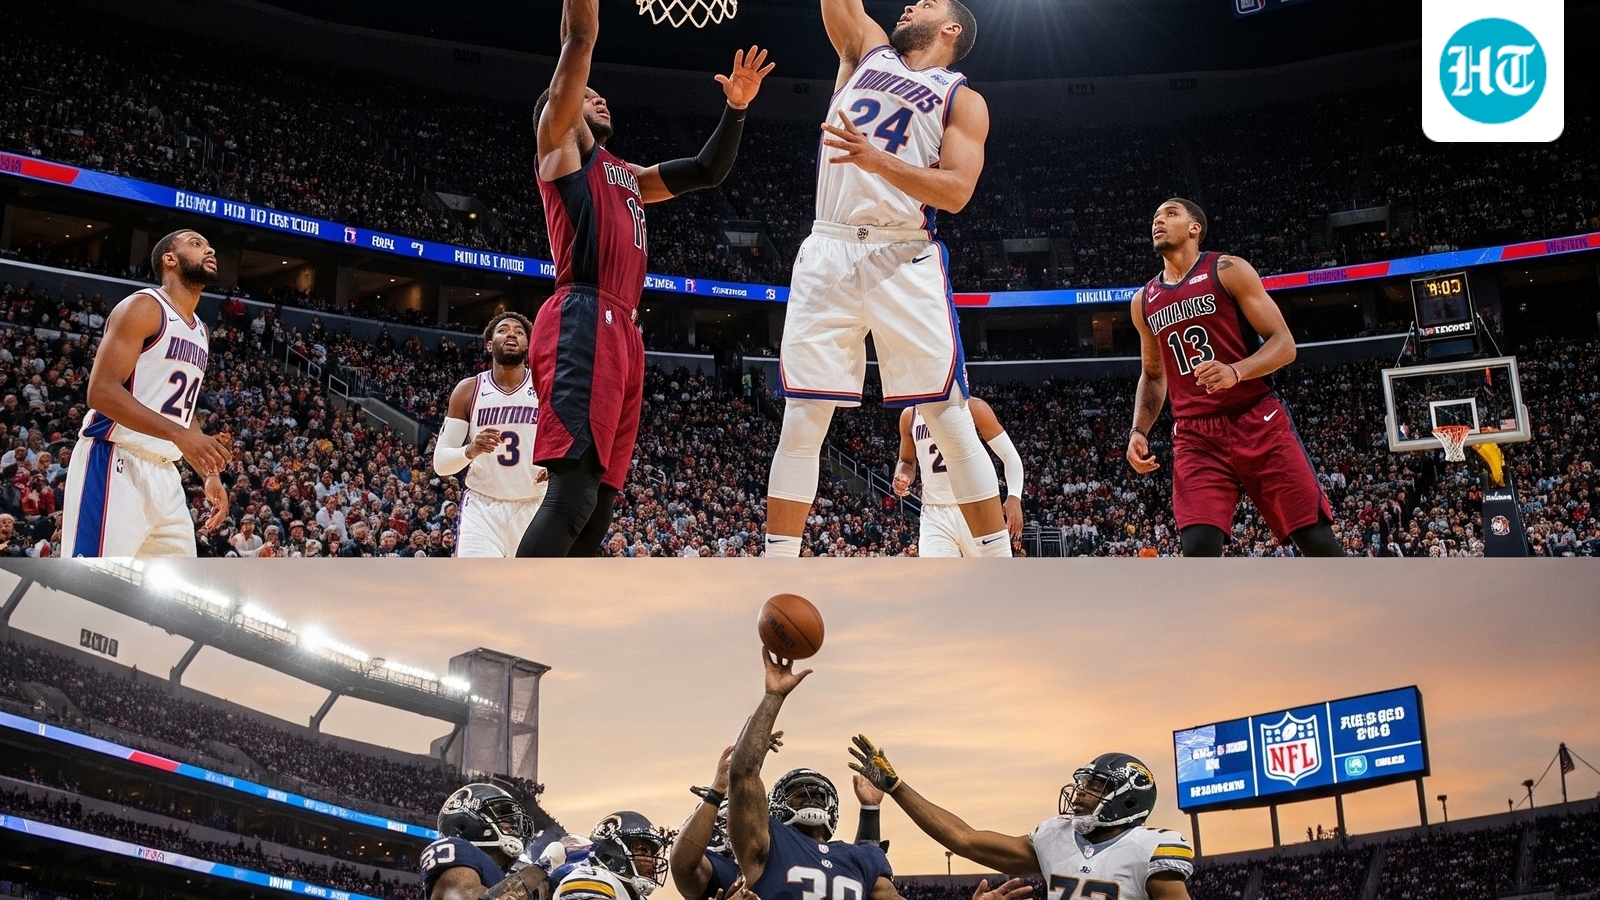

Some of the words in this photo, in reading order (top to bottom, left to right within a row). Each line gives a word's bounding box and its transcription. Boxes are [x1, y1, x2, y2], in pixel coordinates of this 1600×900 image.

[849, 98, 914, 155] 24
[1167, 325, 1215, 375] 13
[160, 370, 201, 423] 24
[496, 430, 520, 467] 3
[1269, 743, 1315, 774] NFL
